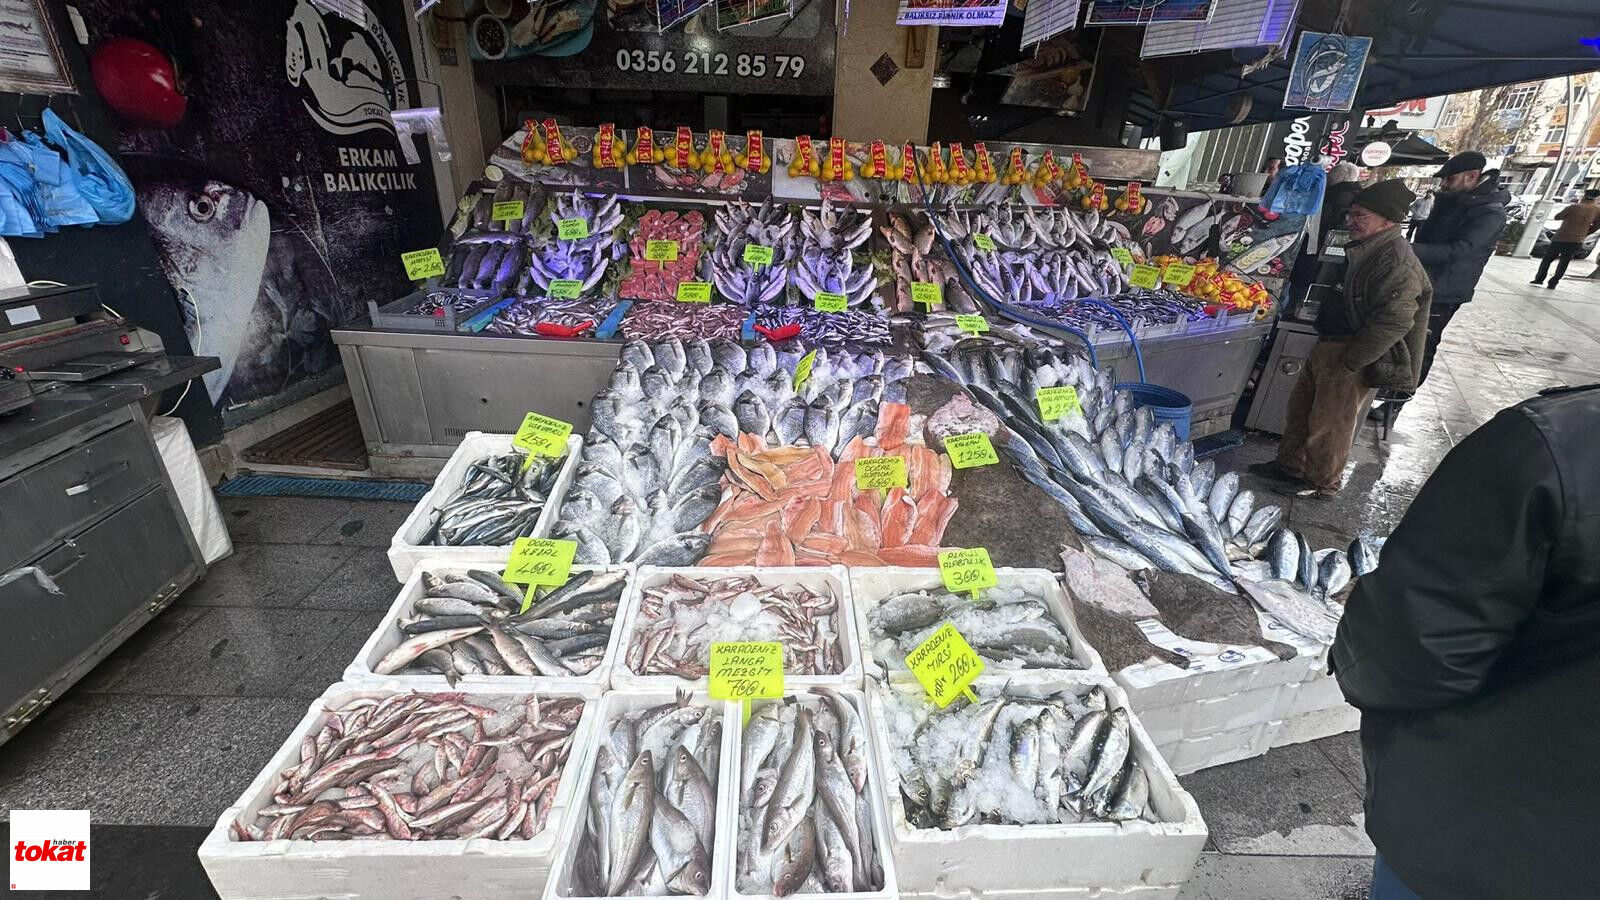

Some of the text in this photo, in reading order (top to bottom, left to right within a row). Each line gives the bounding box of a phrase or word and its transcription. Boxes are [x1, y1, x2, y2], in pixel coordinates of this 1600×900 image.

[966, 11, 995, 19] OLMAZ
[616, 49, 805, 78] 0356 212 85 79
[1283, 115, 1312, 167] ooper
[338, 147, 398, 167] ERKAM
[323, 173, 417, 195] BALIKÇILIK
[958, 449, 987, 463] 1250
[952, 569, 980, 585] 300
[721, 655, 765, 666] LANGA
[949, 653, 970, 685] 200
[727, 679, 760, 697] 700
